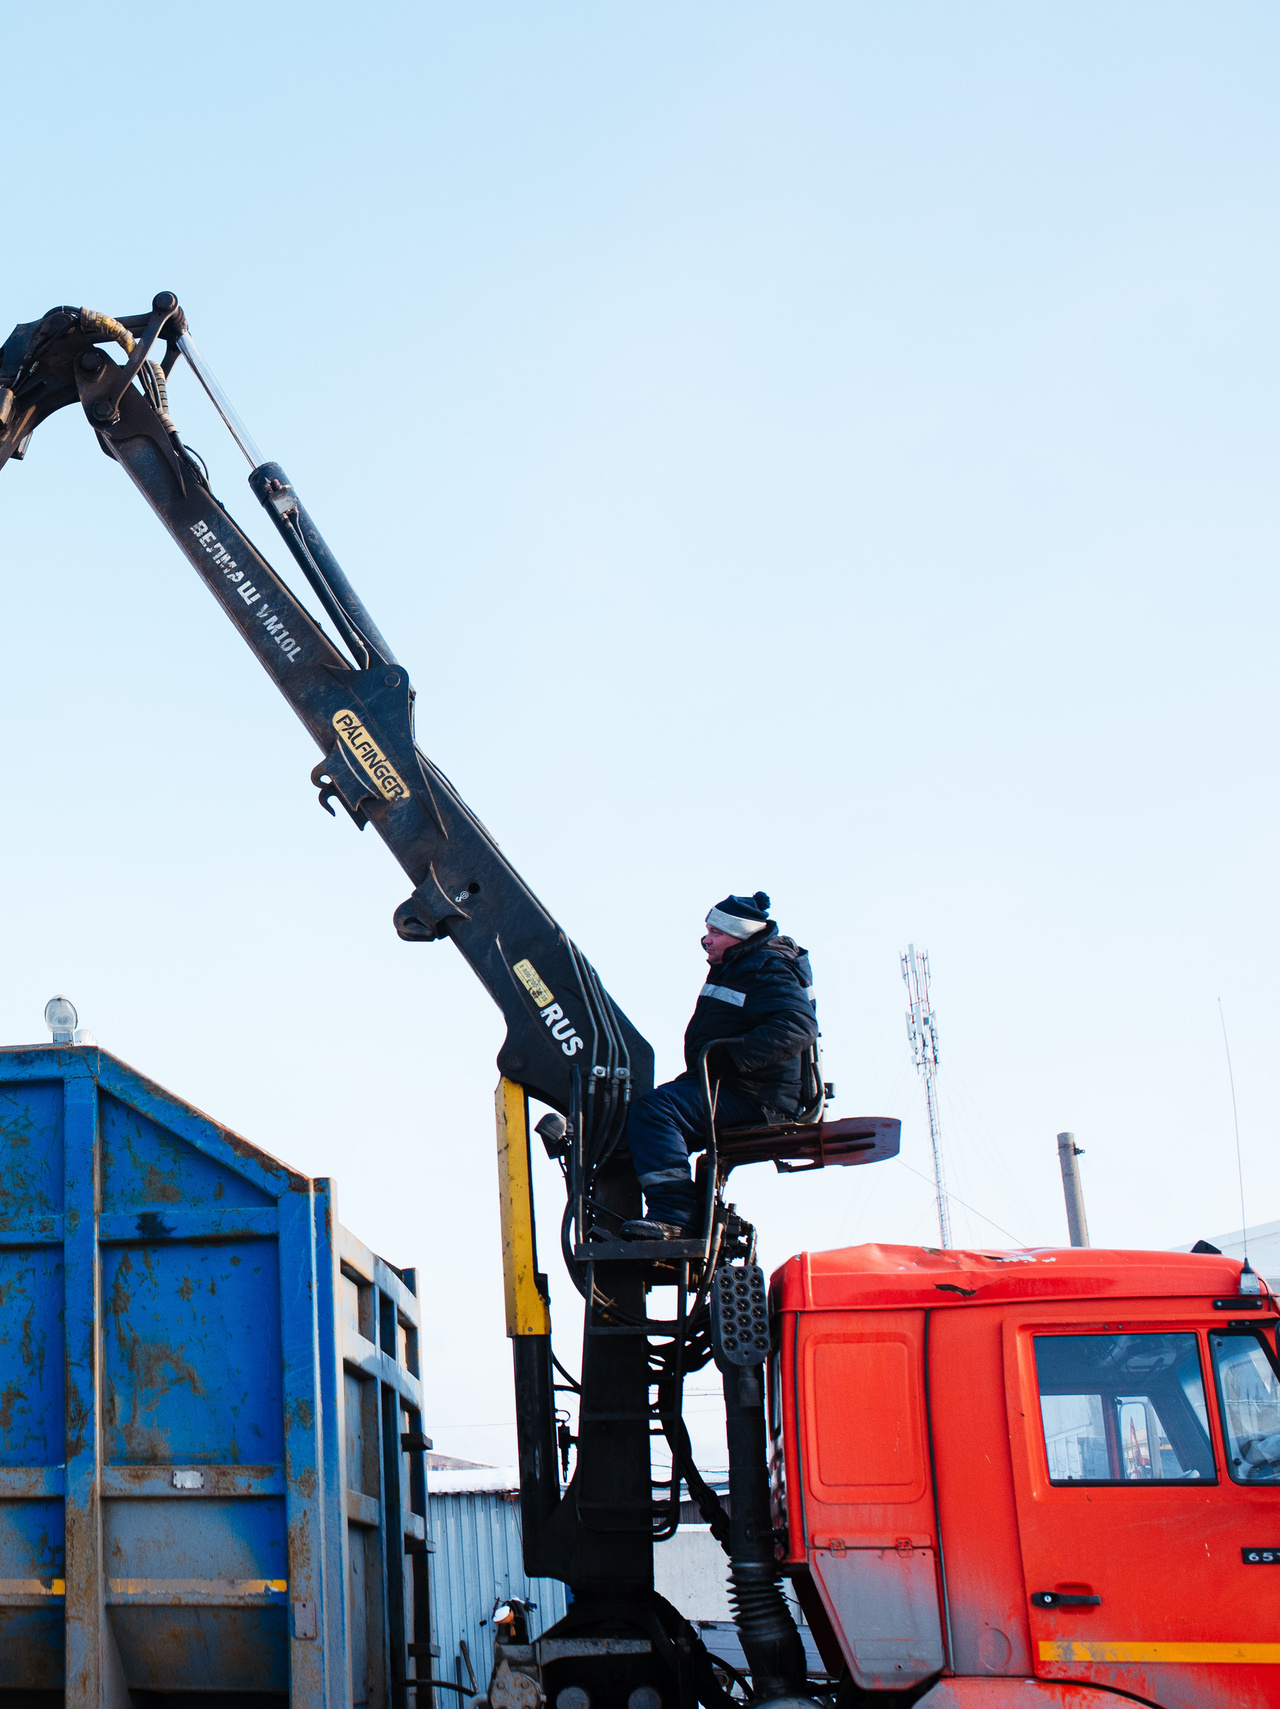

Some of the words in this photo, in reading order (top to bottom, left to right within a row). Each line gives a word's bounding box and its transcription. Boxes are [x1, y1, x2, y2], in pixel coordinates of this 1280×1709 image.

[189, 519, 262, 606] ВЕЛМАШ
[336, 714, 405, 800] PALFINGER
[540, 1002, 584, 1056] RUS
[1248, 1552, 1280, 1562] 65
